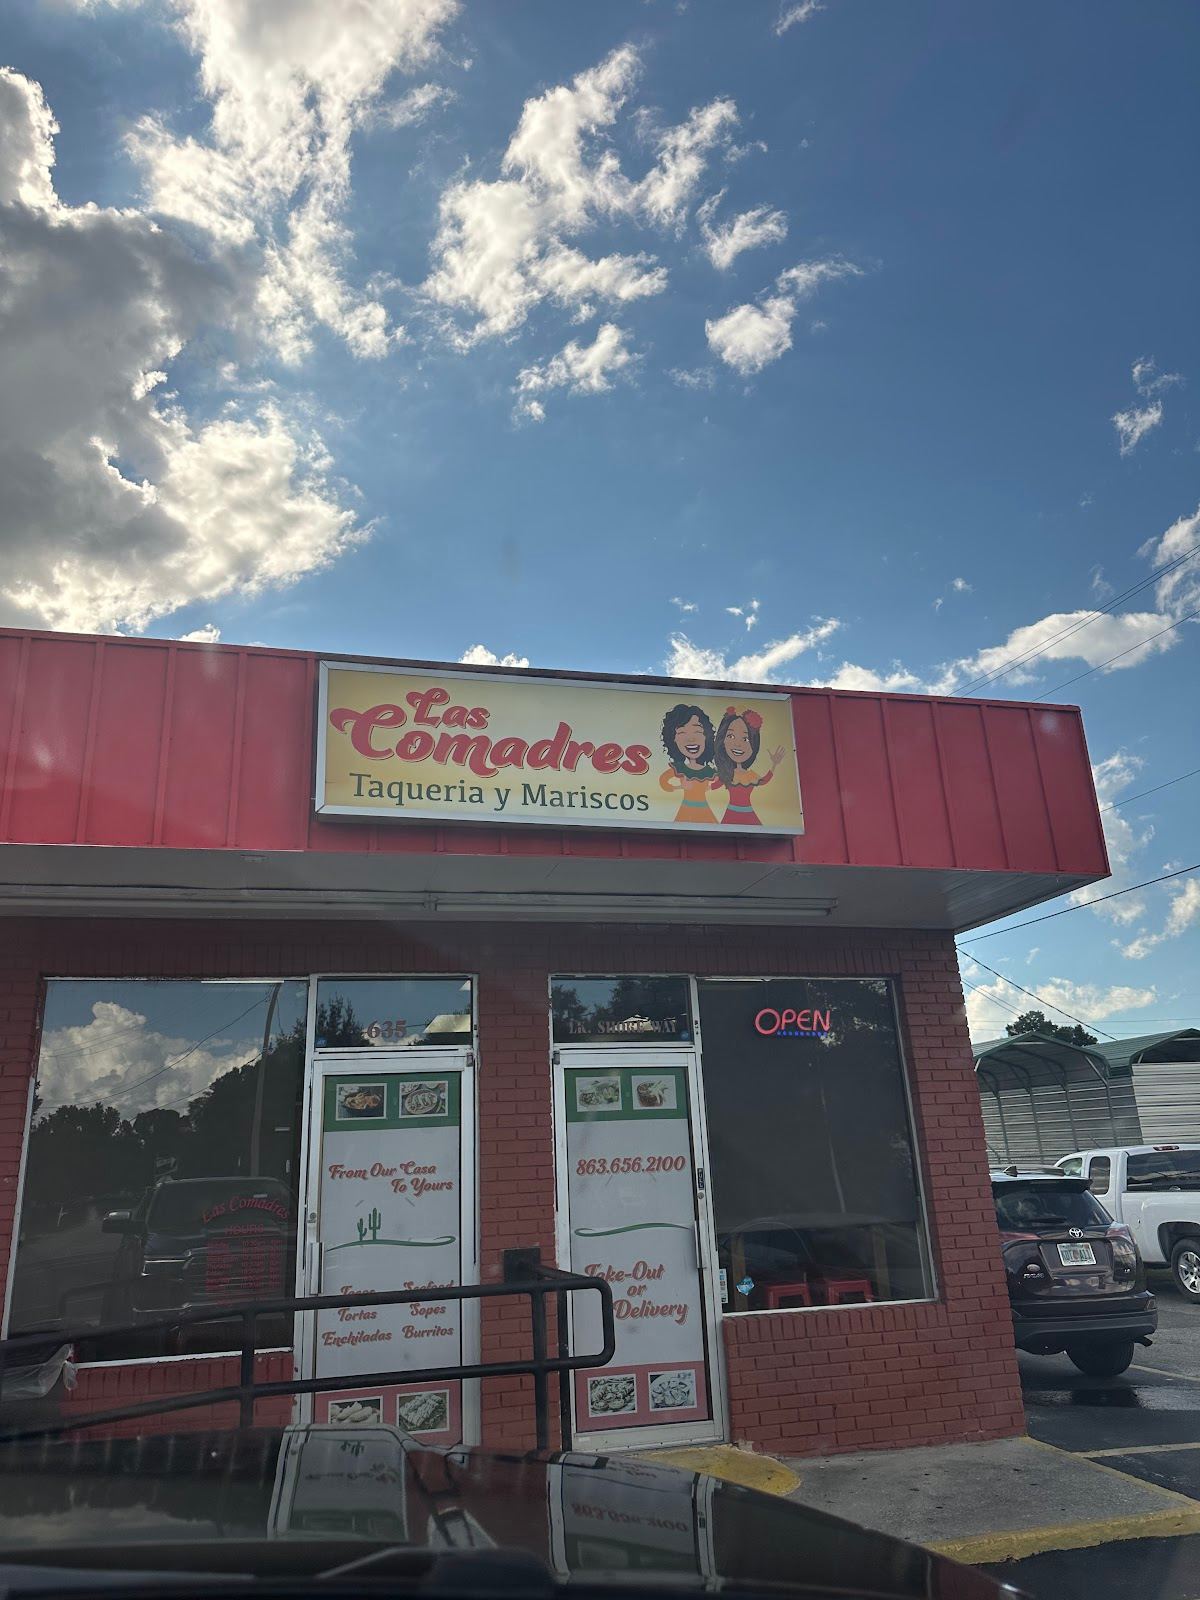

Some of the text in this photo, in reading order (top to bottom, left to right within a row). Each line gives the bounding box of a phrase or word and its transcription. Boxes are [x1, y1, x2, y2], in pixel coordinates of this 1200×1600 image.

[405, 687, 490, 730] Las
[329, 703, 652, 778] Comadres
[349, 772, 650, 812] Taqueria y Mariscos
[367, 1020, 407, 1039] 635
[755, 1007, 831, 1035] OPEN
[328, 1161, 437, 1180] From Our Casa
[576, 1155, 686, 1176] 863.656.2100
[391, 1177, 453, 1196] To Yours
[584, 1260, 665, 1282] Take-Out
[627, 1284, 647, 1296] or
[338, 1308, 378, 1322] Tortas
[409, 1303, 447, 1319] Sopes
[612, 1299, 689, 1325] Delivery
[321, 1330, 393, 1347] Enchiladas
[401, 1325, 454, 1339] Burritos
